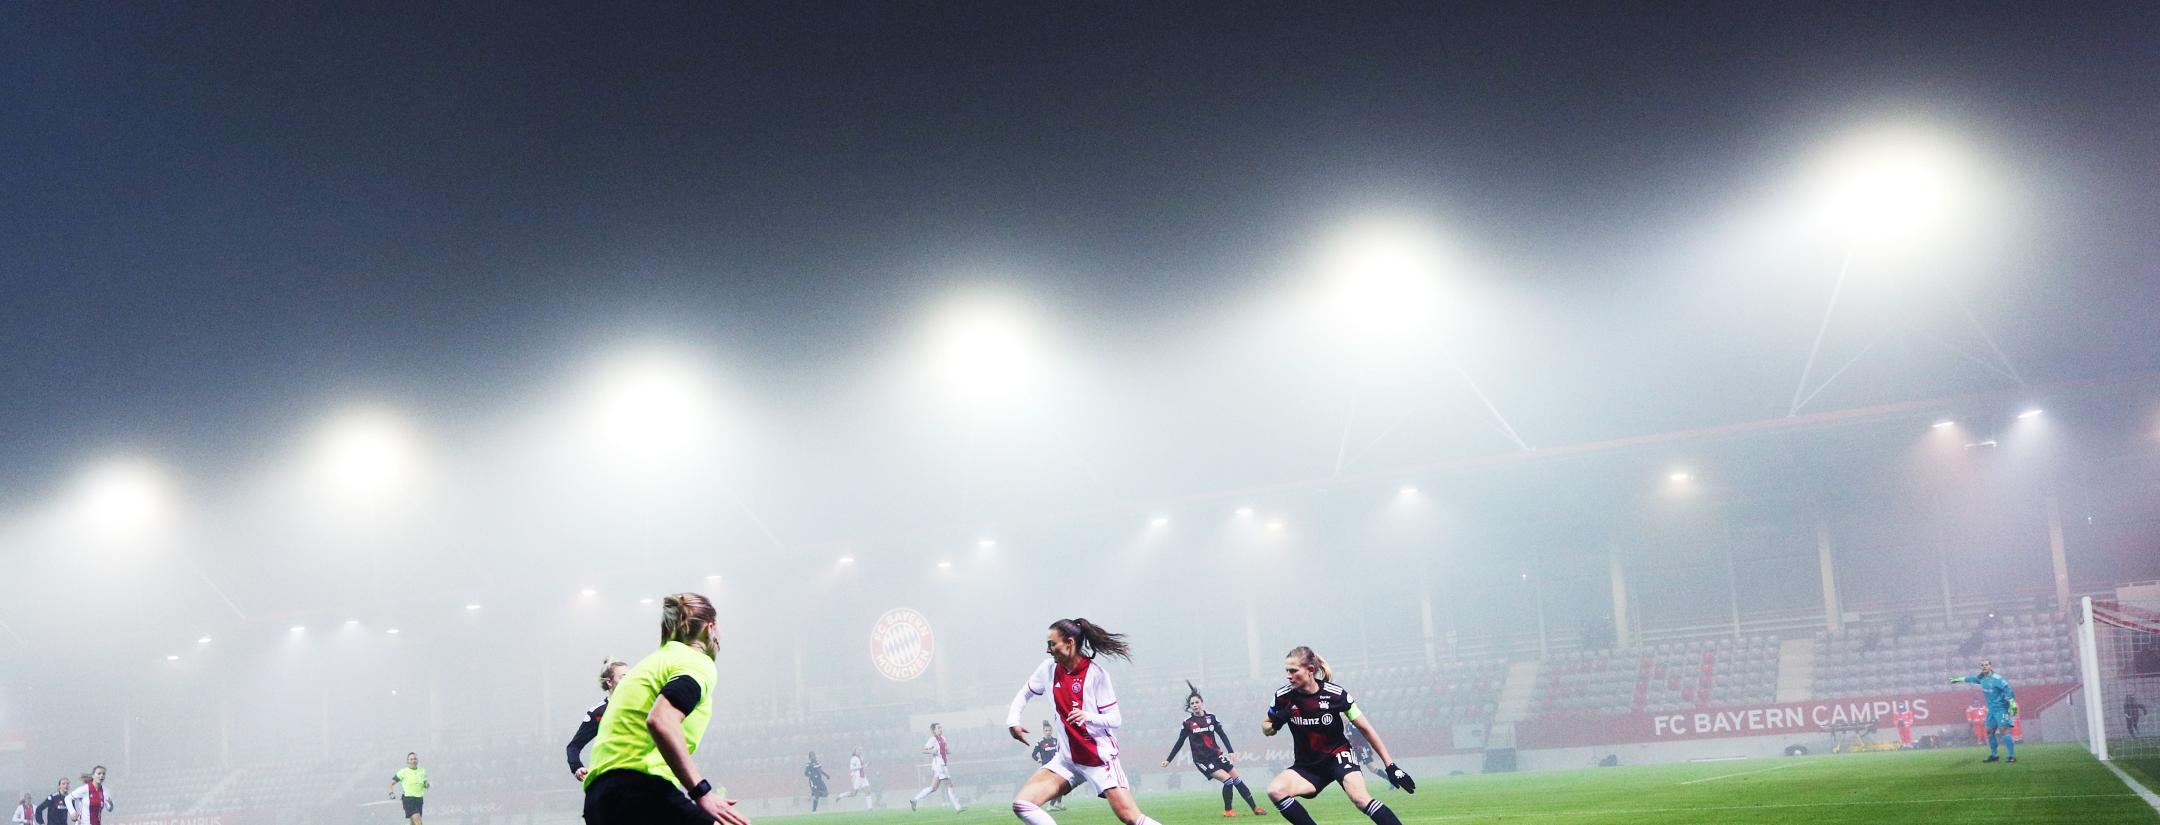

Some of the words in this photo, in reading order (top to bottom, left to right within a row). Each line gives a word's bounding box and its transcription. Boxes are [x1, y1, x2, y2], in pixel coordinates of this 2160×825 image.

[872, 624, 887, 640] FC
[886, 612, 929, 636] BAYERN
[1290, 716, 1320, 726] Allianz
[1654, 714, 1687, 736] FC
[1694, 706, 1804, 733] BAYERN
[1811, 699, 1929, 726] CAMPUS
[1335, 750, 1352, 765] 19
